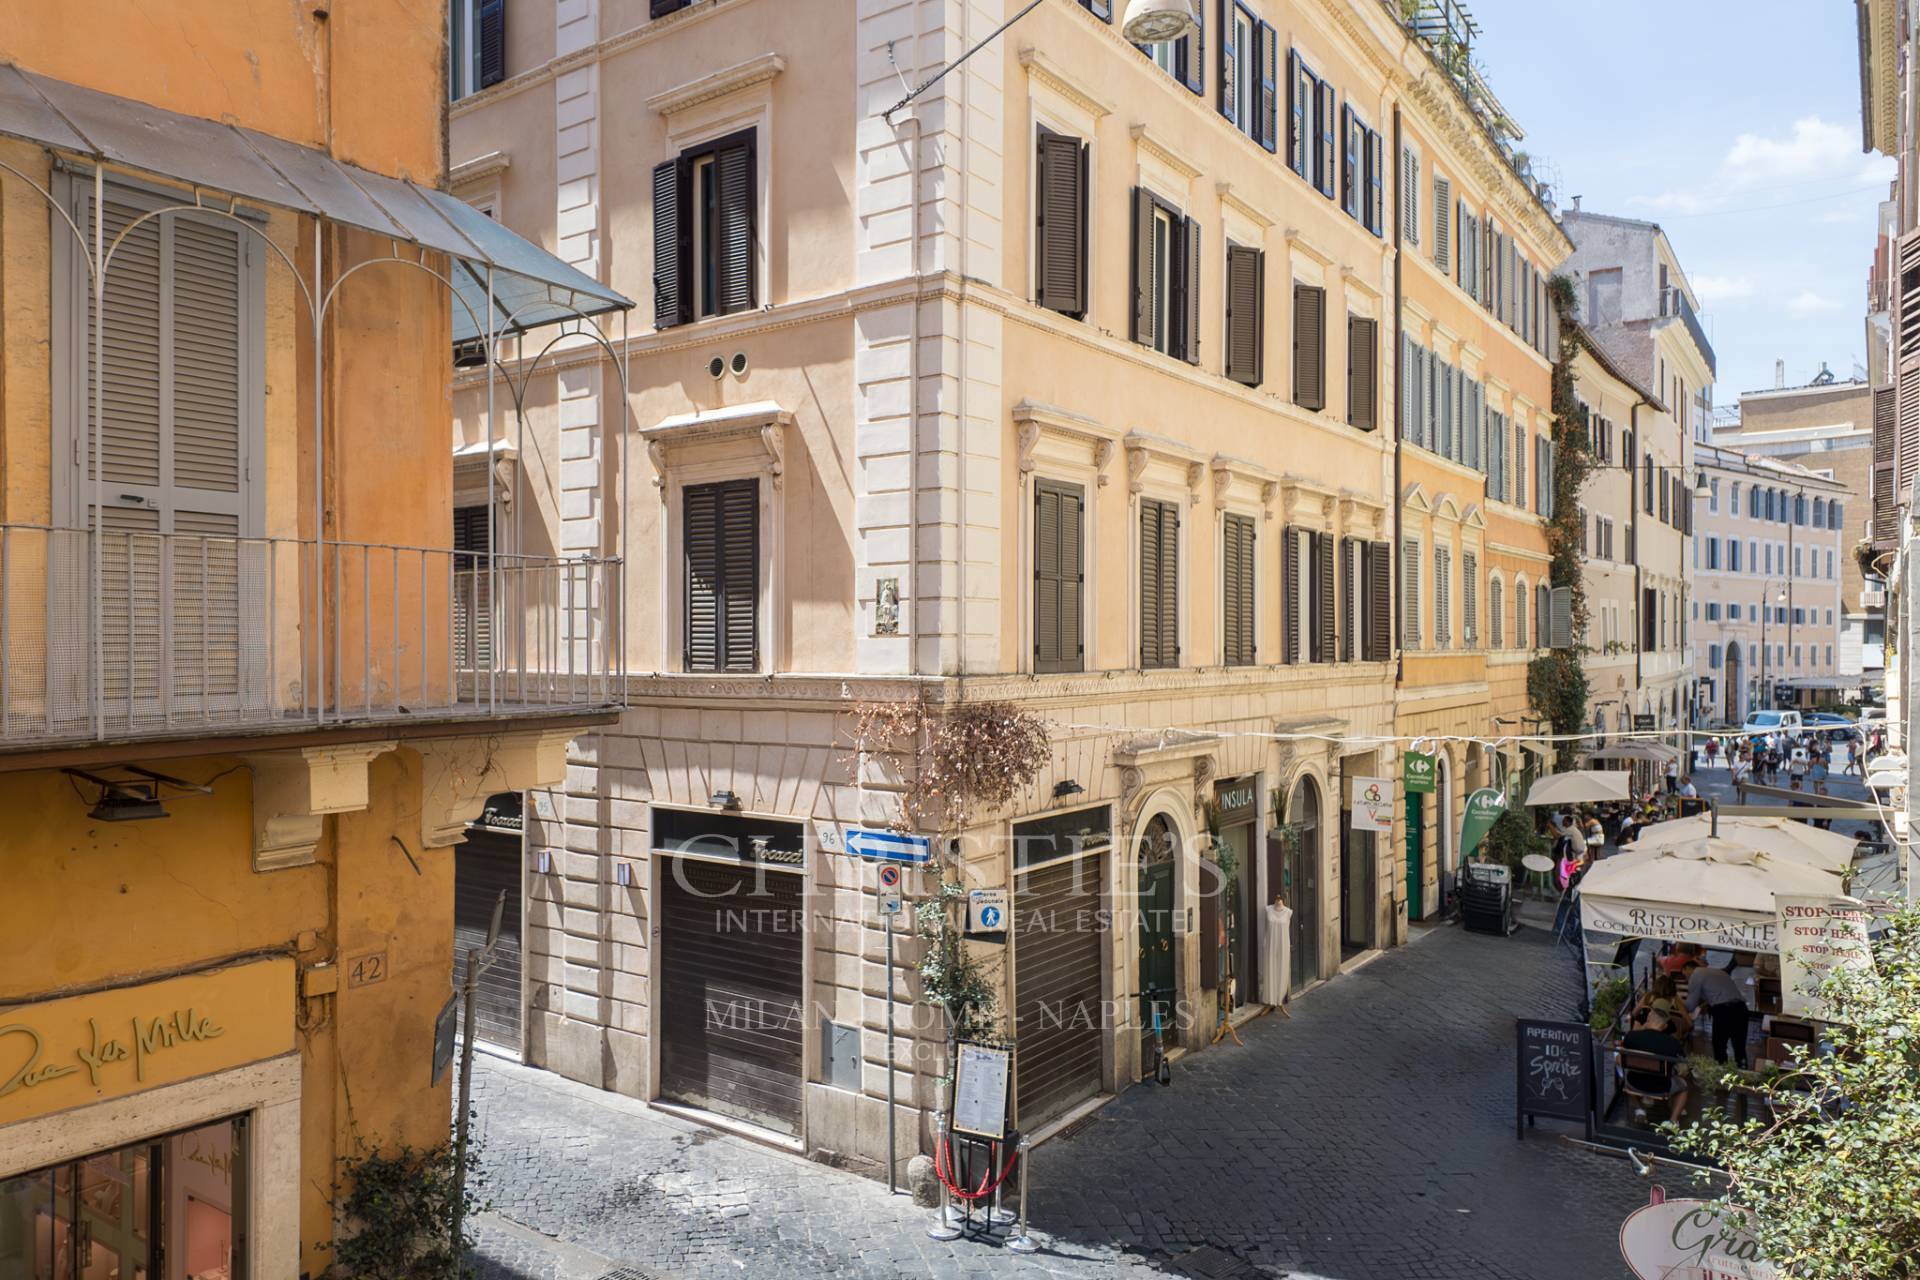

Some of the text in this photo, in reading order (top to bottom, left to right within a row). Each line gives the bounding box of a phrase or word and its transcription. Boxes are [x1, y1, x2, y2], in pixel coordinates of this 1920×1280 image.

[1221, 786, 1254, 810] INSULA
[822, 832, 835, 845] 96
[1785, 906, 1825, 918] STOP
[1593, 919, 1654, 936] COCKTAIL
[1629, 908, 1777, 942] RISTORANTE
[1794, 926, 1827, 937] STOP
[1718, 934, 1770, 951] BAKERY
[1803, 944, 1829, 954] STOP
[351, 956, 382, 983] 42
[1529, 1055, 1581, 1079] Spritz
